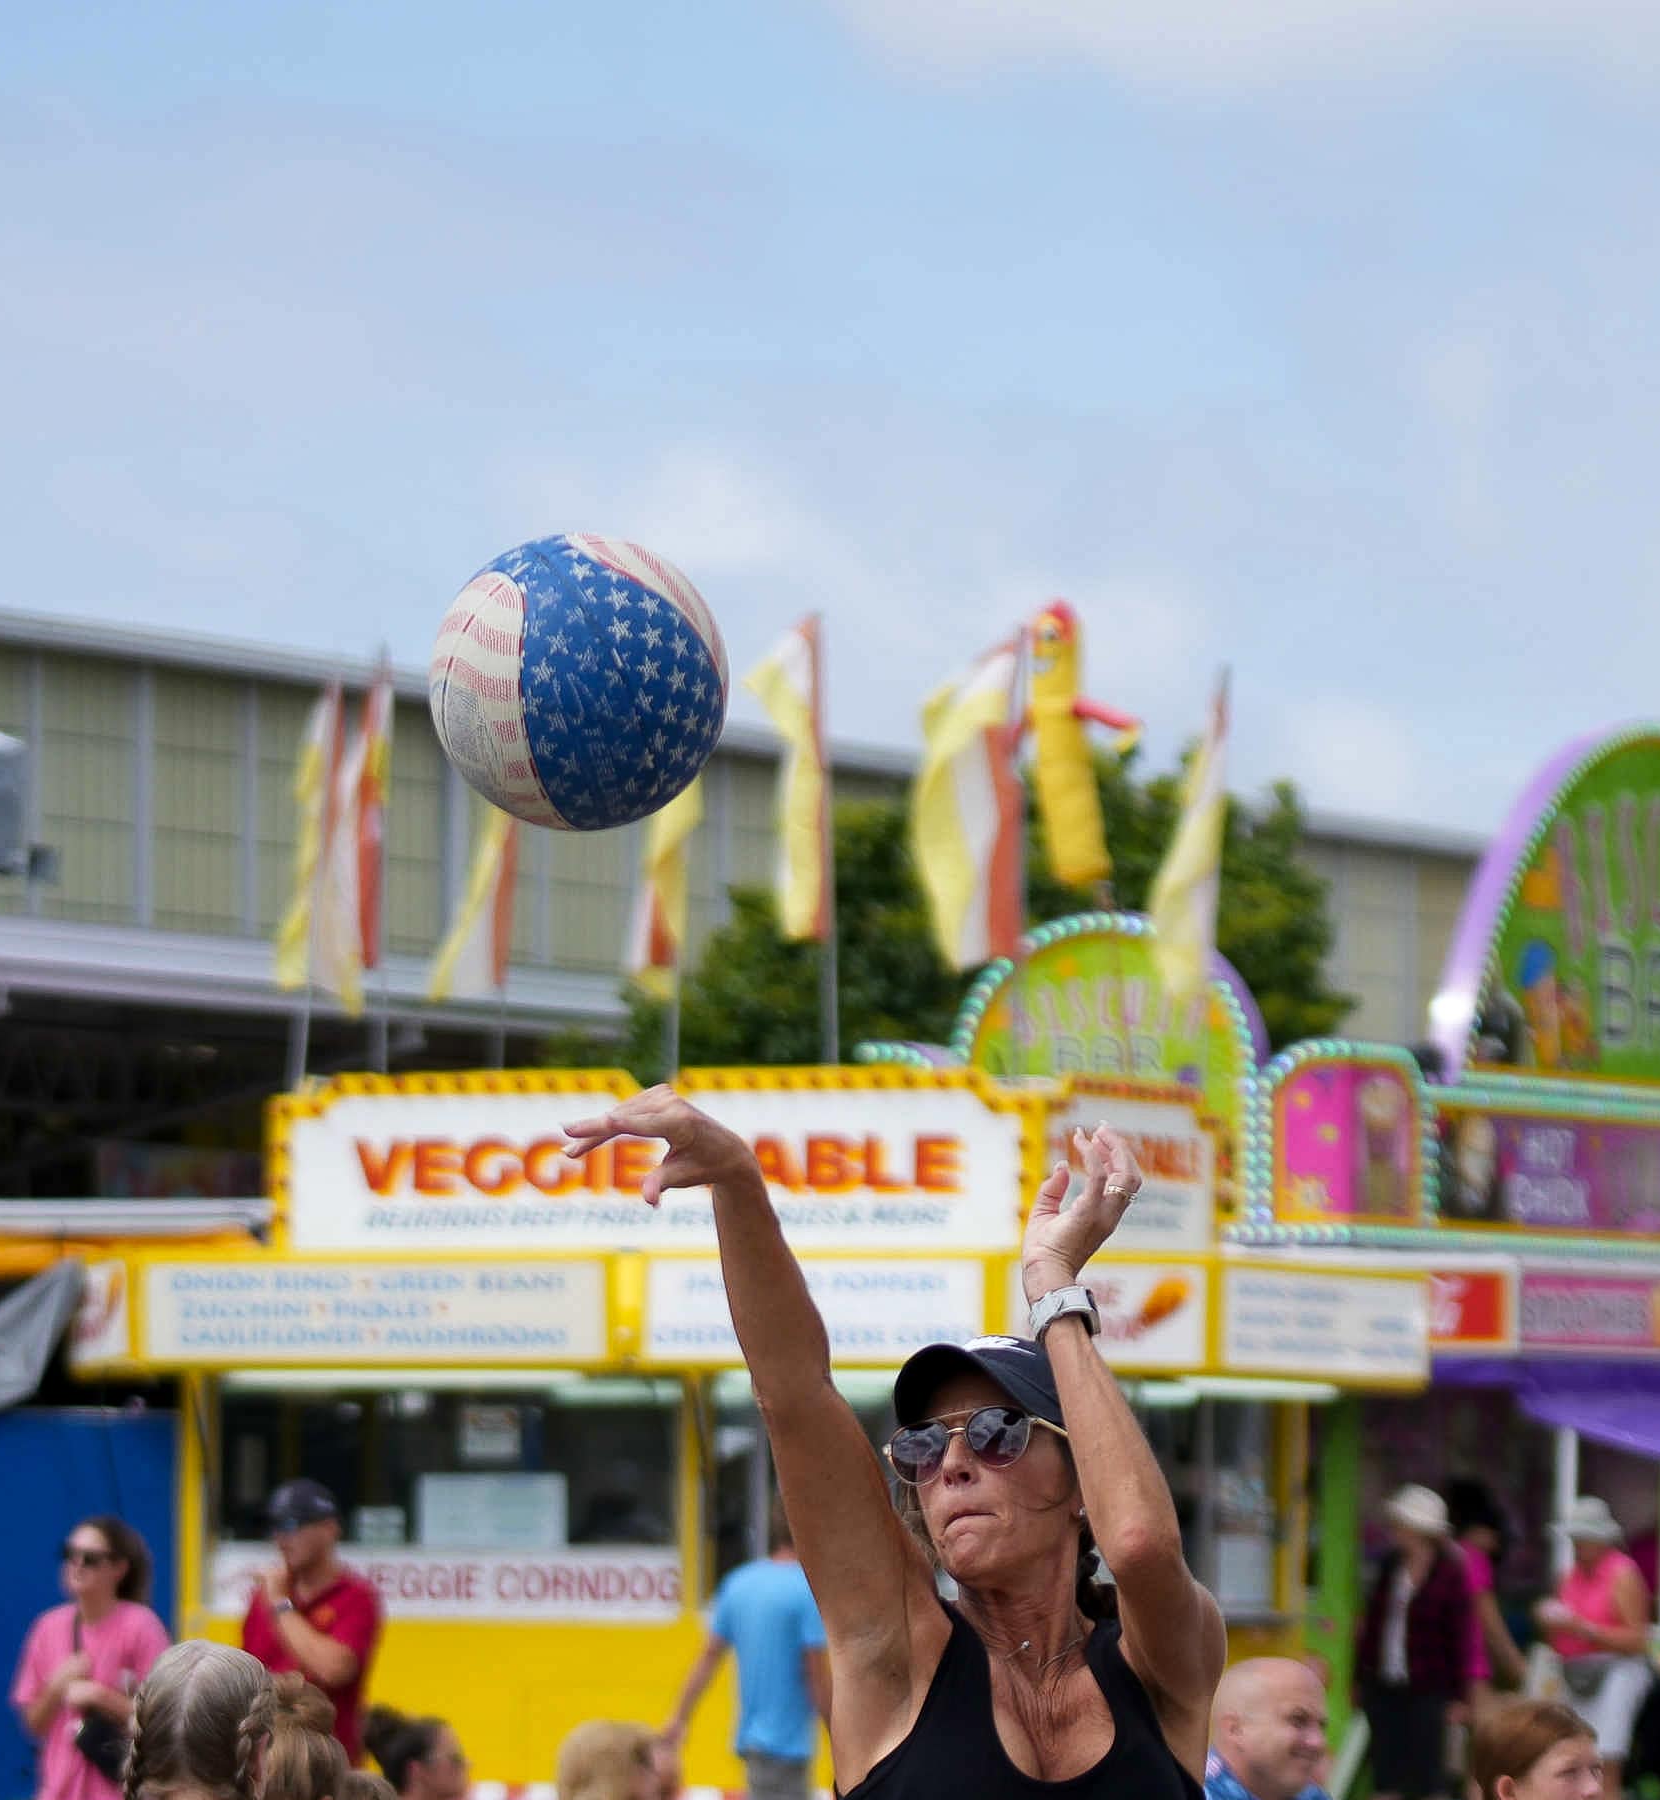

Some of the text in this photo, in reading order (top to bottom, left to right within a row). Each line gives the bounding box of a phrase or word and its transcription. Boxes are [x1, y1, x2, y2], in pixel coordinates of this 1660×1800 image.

[353, 1132, 965, 1196] VEGGIE ABLE
[494, 1564, 682, 1604] CORNDOG
